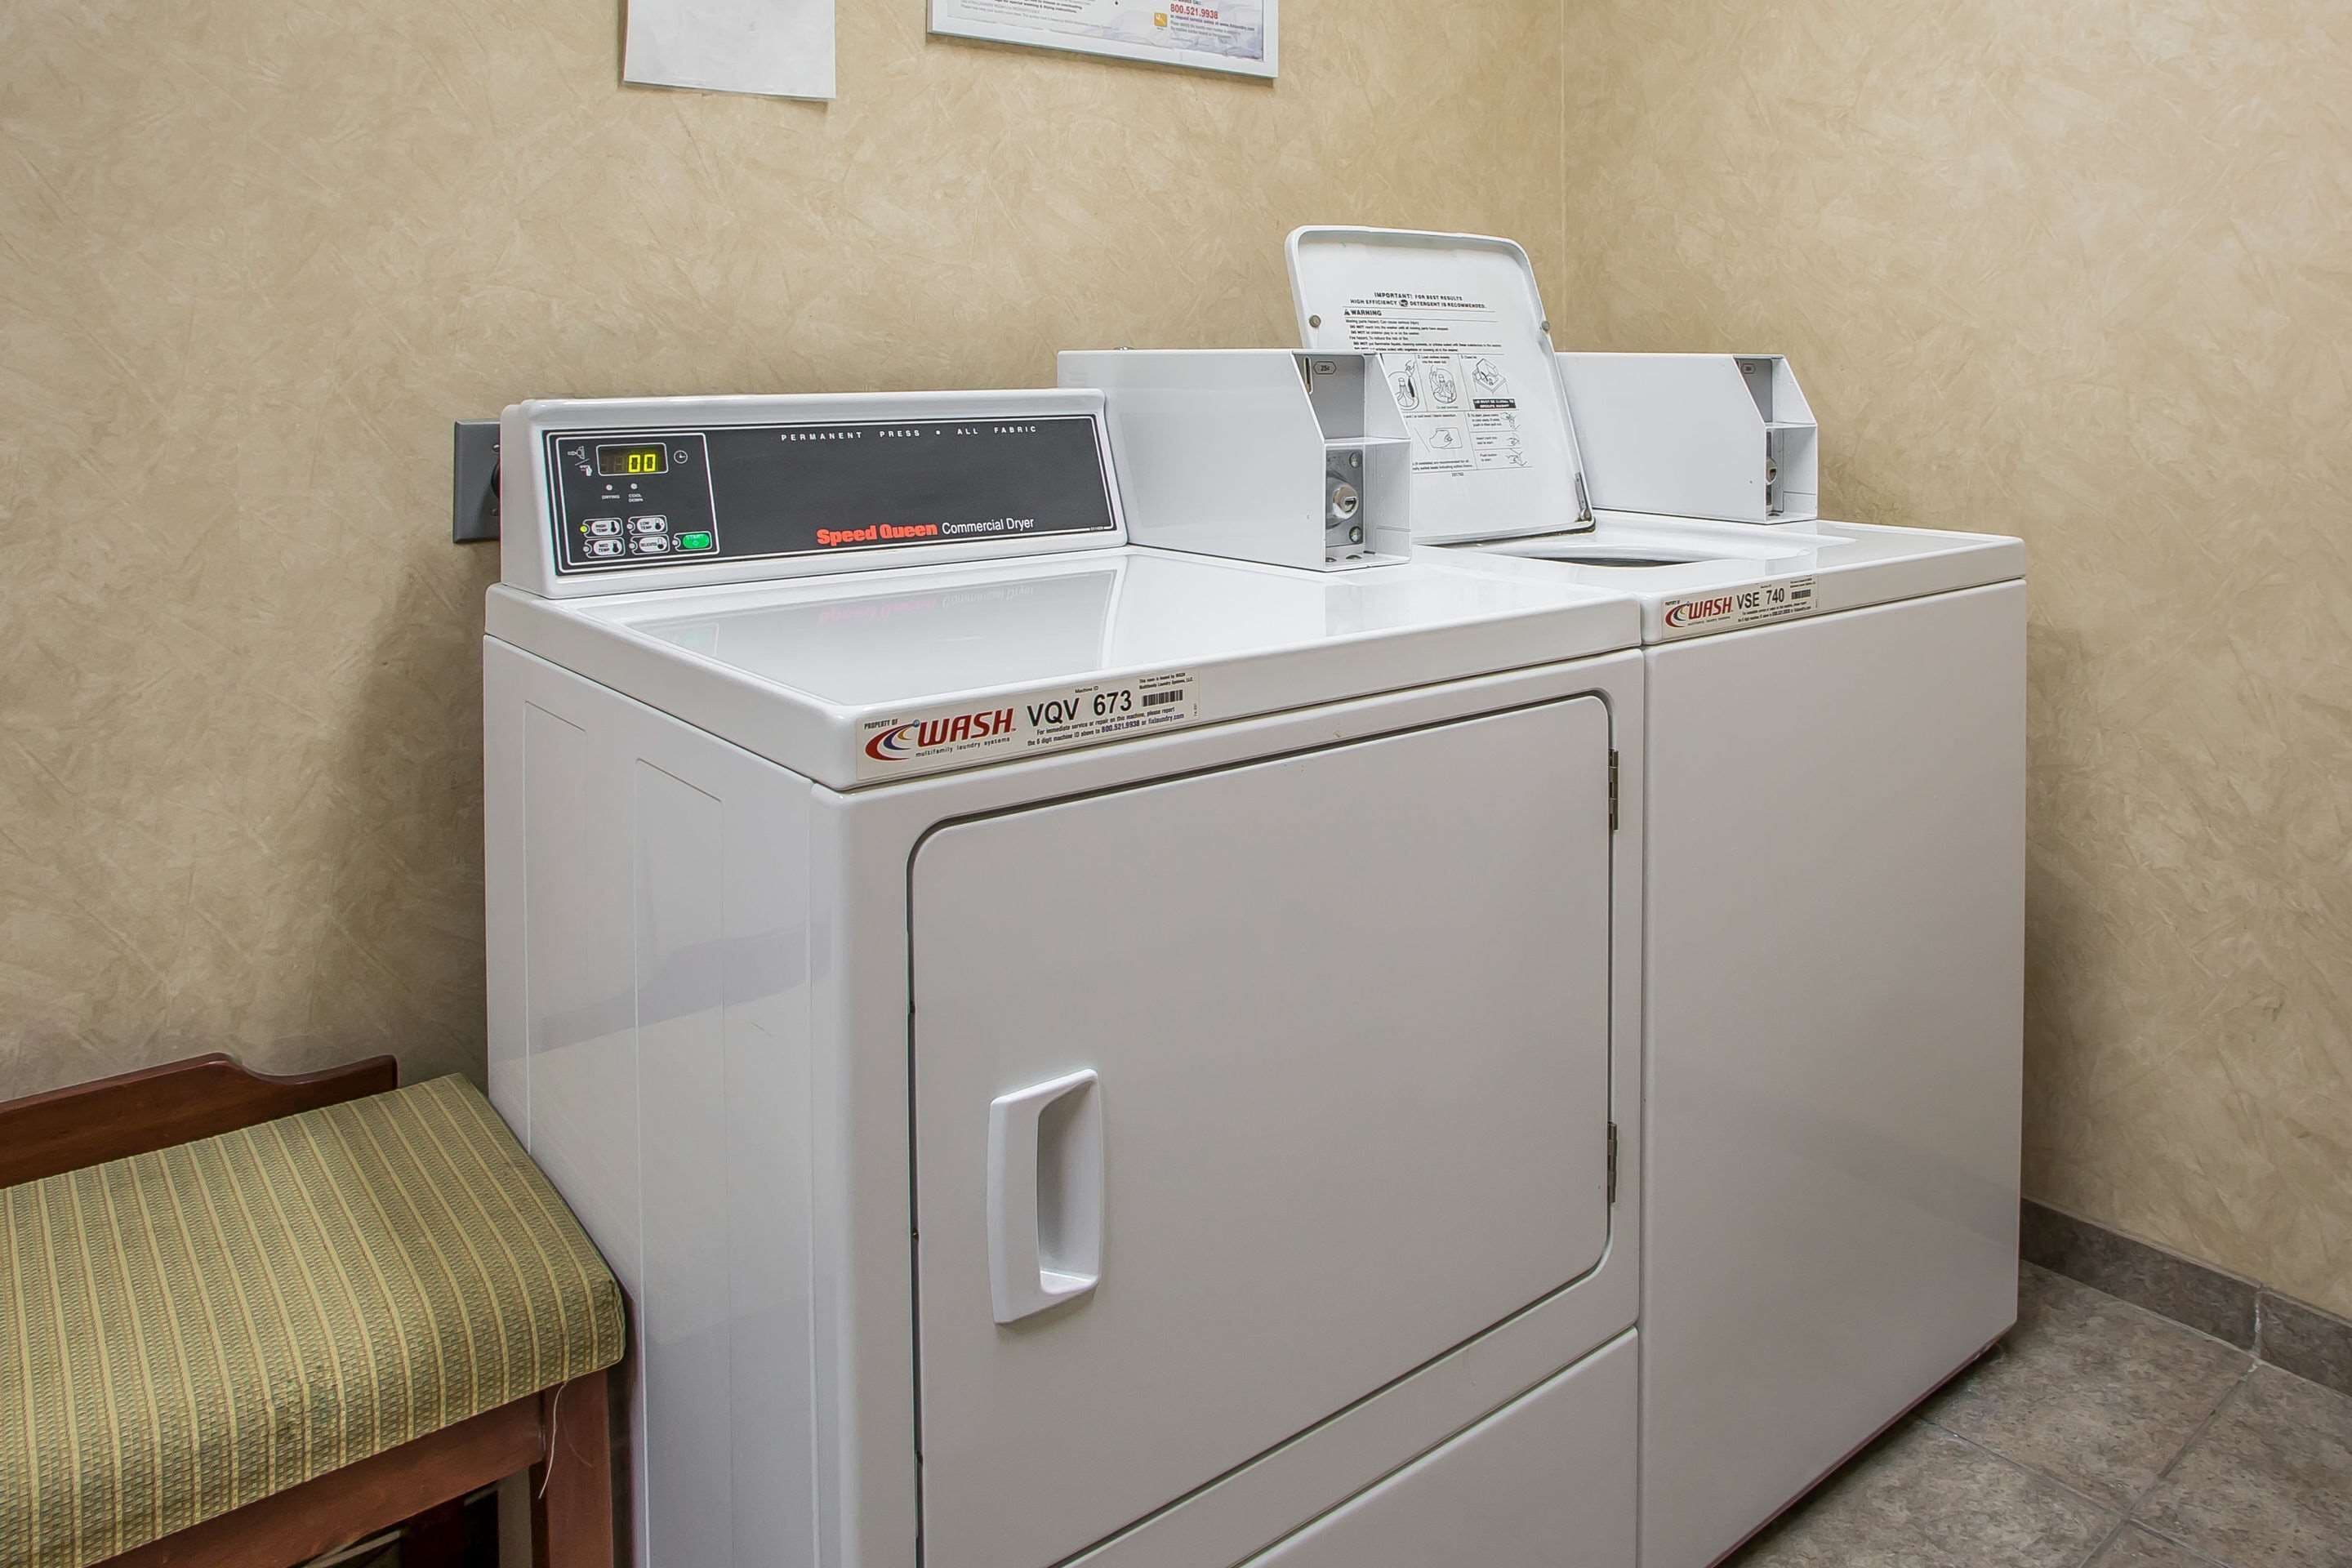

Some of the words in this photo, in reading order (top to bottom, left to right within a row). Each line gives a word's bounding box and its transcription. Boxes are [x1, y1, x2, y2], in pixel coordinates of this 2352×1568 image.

[1170, 3, 1218, 20] 800.521.9938
[781, 431, 862, 442] PERMANENT
[880, 430, 921, 438] PRESS
[957, 427, 978, 435] ALL
[993, 425, 1037, 434] FABRIC
[628, 453, 656, 473] 00
[817, 525, 877, 546] Speed
[879, 523, 938, 540] Queen
[942, 518, 1004, 535] Commercial
[1006, 516, 1035, 531] Dryer
[1688, 596, 1732, 620] WASH
[1736, 591, 1760, 609] VSE
[1766, 587, 1784, 605] 740
[1027, 697, 1080, 727] VQV
[1094, 689, 1132, 716] 673
[864, 719, 890, 730] PROPERTY
[891, 718, 898, 726] OF
[917, 708, 1013, 747] WASH
[1046, 725, 1071, 733] immediate
[1101, 719, 1140, 733] 800.521.9938
[915, 746, 953, 757] multifamily
[956, 742, 981, 751] laundry
[983, 737, 1010, 746] systems
